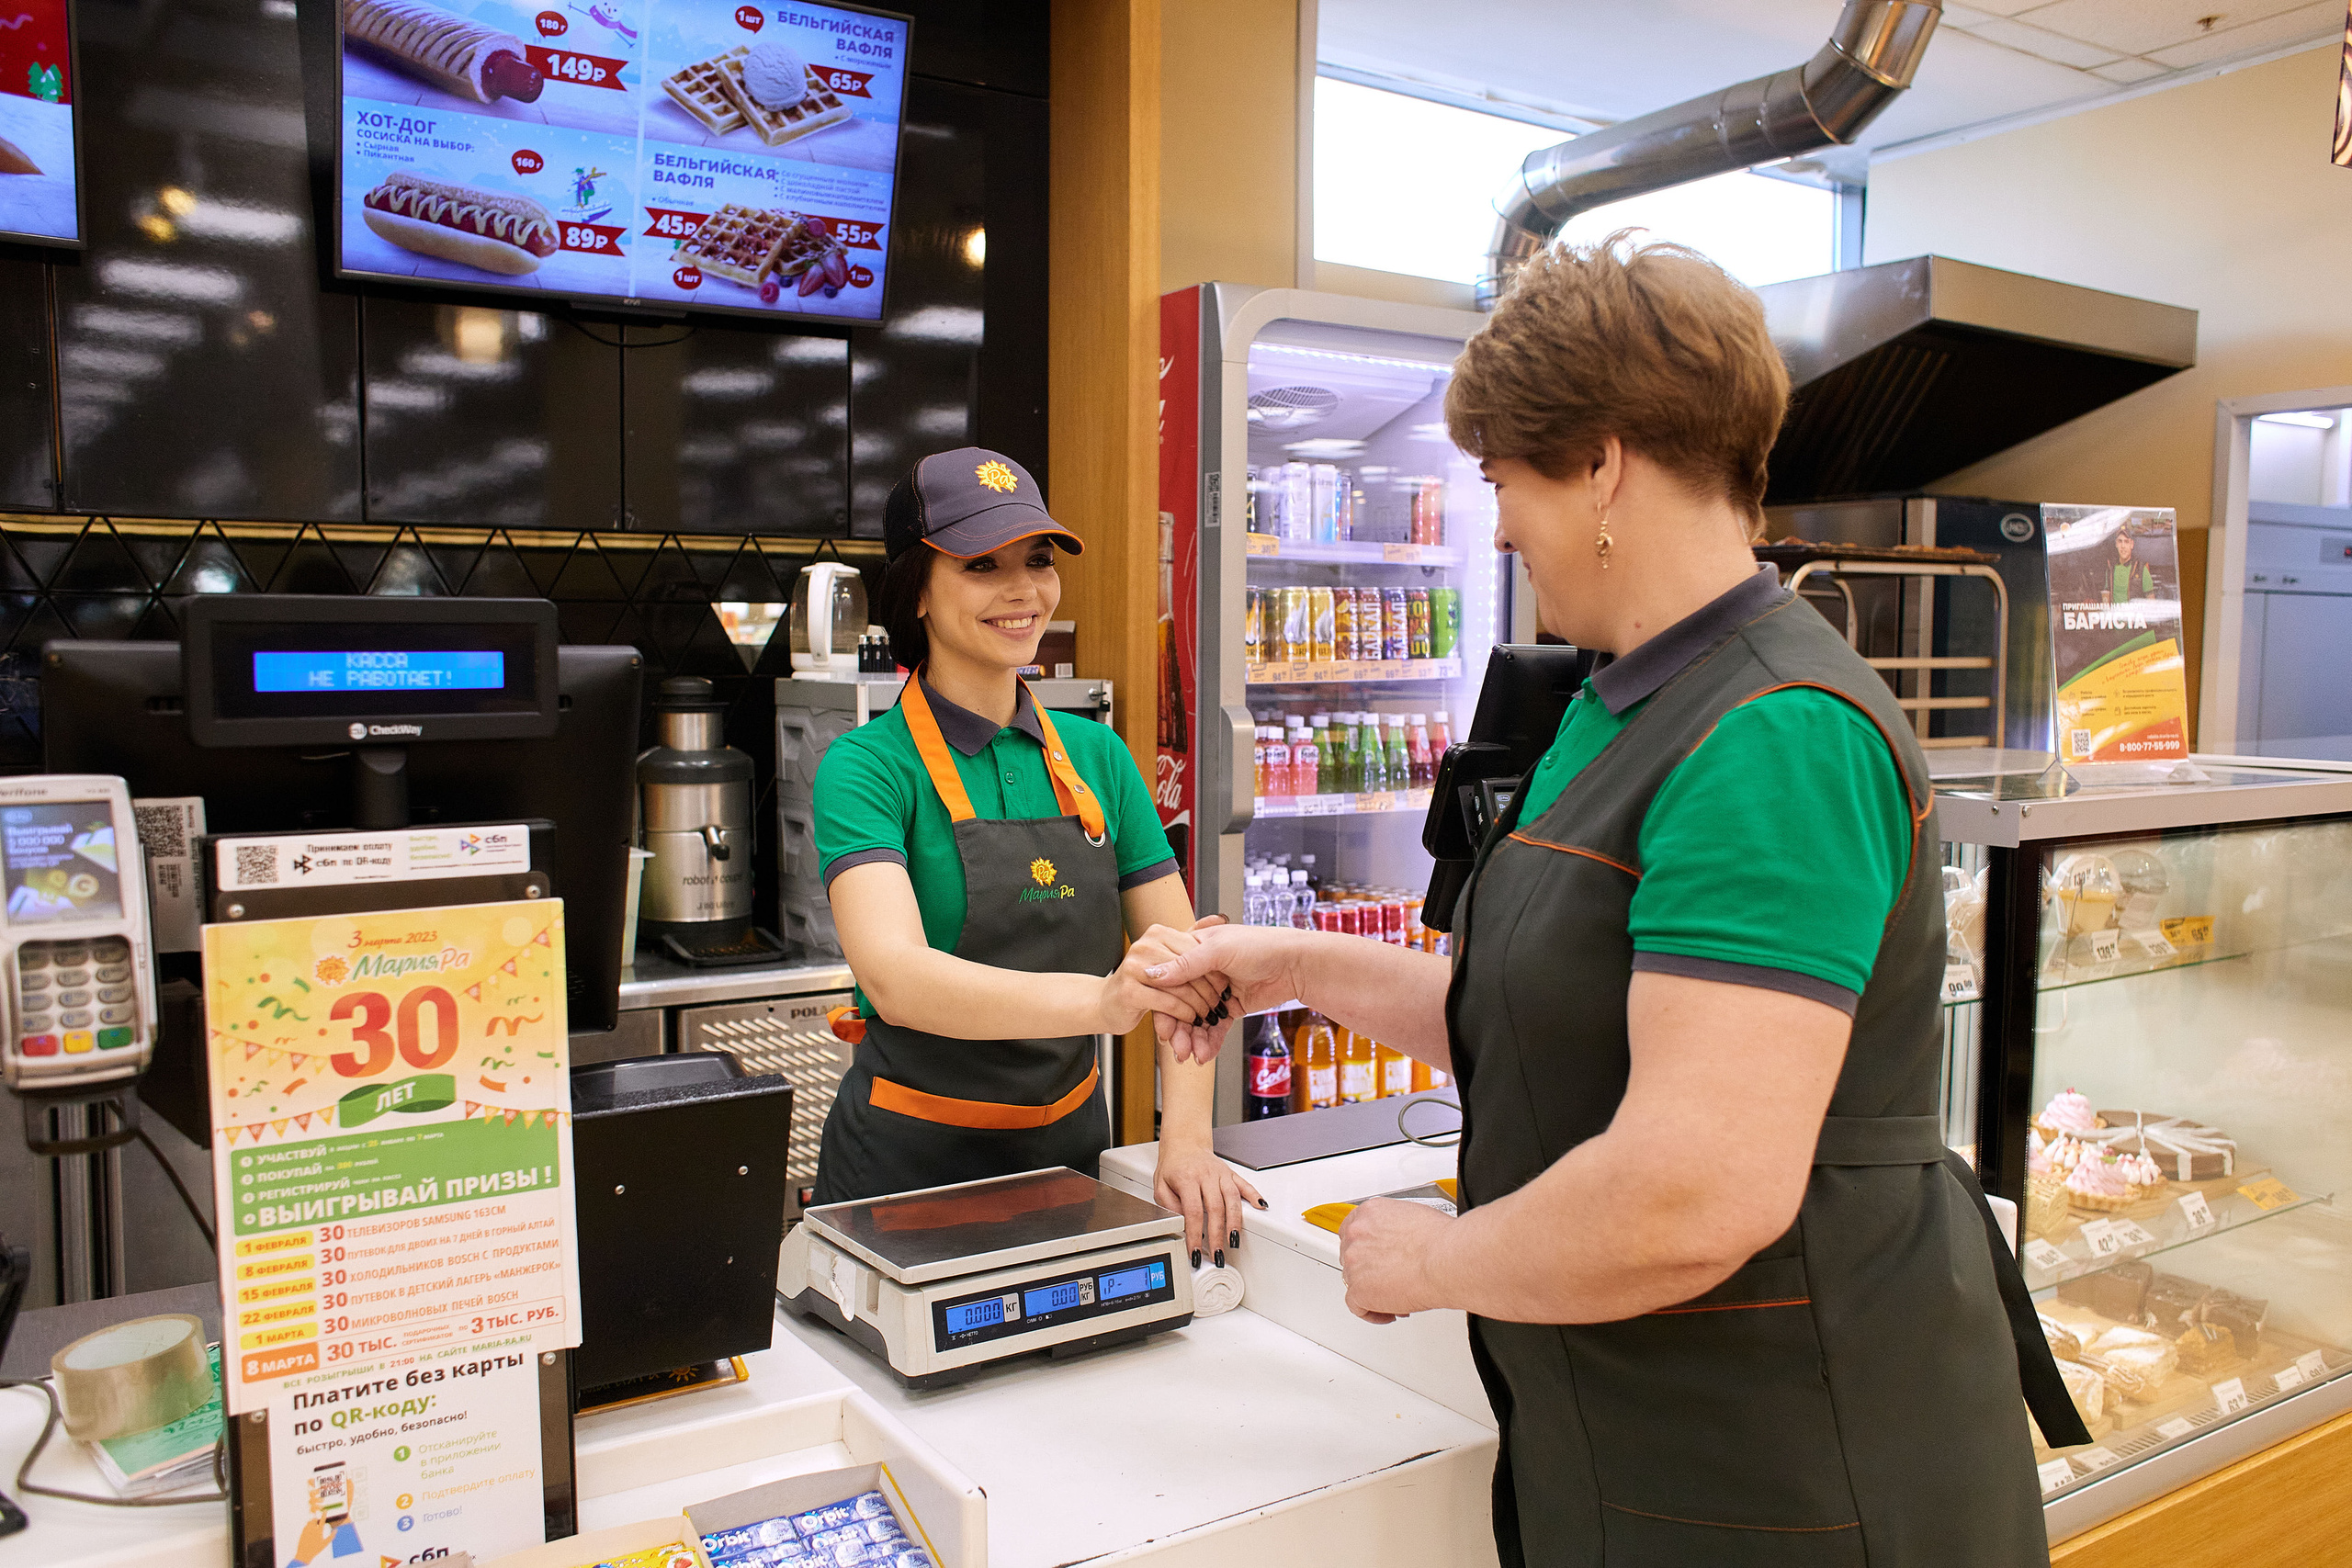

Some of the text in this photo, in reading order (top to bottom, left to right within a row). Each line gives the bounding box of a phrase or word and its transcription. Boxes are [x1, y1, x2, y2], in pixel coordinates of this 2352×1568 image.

[540, 18, 559, 30] 180
[777, 11, 895, 43] БЕЛЬГИЙСКАЯ
[836, 39, 893, 59] ВАФЛЯ
[356, 111, 436, 135] ХОТ-ДОГ
[357, 130, 475, 153] СОСИСКА НА ВЫБОР:
[364, 141, 399, 153] Сырная
[364, 150, 414, 164] Пикантная
[515, 157, 535, 168] 160
[654, 152, 776, 181] БЕЛЬГИЙСКАЯ
[653, 169, 714, 189] ВАФЛЯ
[989, 469, 1010, 484] Ра
[2064, 612, 2148, 630] БАРИСТА
[345, 652, 409, 668] КАССА
[309, 671, 452, 687] НЕ РАБОТАЕТ!
[369, 725, 422, 736] CheckWay
[307, 842, 392, 853] Принимаем оплату
[485, 835, 507, 843] сбп
[346, 931, 363, 948] 3
[405, 931, 438, 944] 2023
[329, 985, 459, 1078] 30
[375, 1081, 418, 1113] ЛЕТ
[257, 1144, 327, 1166] УЧАСТВУЙ
[257, 1162, 322, 1182] ПОКУПАЙ
[258, 1177, 351, 1201] РЕГИСТРИРУЙ
[258, 1166, 552, 1227] ВЫИГРЫВАЙ ПРИЗЫ !
[320, 1224, 345, 1243] 30
[347, 1218, 420, 1238] ТЕЛЕВИЗОРОВ
[422, 1210, 471, 1226] SAMSUNG
[244, 1236, 307, 1253] 1 ФЕВРАЛЯ
[321, 1216, 555, 1264] 30 ПУТЕВОК ДЛЯ ДВОИХ НА 7 ДНЕЙ В ГОРНЫЙ АЛТАЙ
[245, 1259, 308, 1277] 8 ФЕВРАЛЯ
[322, 1239, 560, 1287] 30 ХОЛОДИЛЬНИКОВ BOSCH С ПРОДУКТАМИ
[323, 1261, 561, 1310] 30 ПУТЕВОК В ДЕТСКИЙ ЛАГЕРЬ «МАНЖЕРОК»
[1080, 1281, 1092, 1292] РУБ
[1150, 1271, 1165, 1282] РУБ
[243, 1281, 313, 1301] 15 ФЕВРАЛЯ
[1052, 1286, 1077, 1307] 0.00
[243, 1305, 314, 1325] 22 ФЕВРАЛЯ
[324, 1290, 519, 1334] 30 МИКРОВОЛНОВЫХ ПЕЧЕЙ BOSCH
[965, 1303, 1001, 1325] 0.000
[1005, 1301, 1018, 1314] КГ
[403, 1324, 450, 1337] ПОДАРОЧНЫХ
[470, 1306, 560, 1334] 3 ТЫС. РУБ.
[256, 1329, 305, 1344] 1 МАРТА
[401, 1332, 453, 1346] СЕРТИФИКАТОВ
[327, 1337, 397, 1361] 30 ТЫС.
[246, 1353, 316, 1376] 8 МАРТА
[284, 1379, 301, 1388] ВСЕ
[307, 1365, 374, 1384] РОЗЫГРЫШИ
[390, 1357, 414, 1368] 21:00
[419, 1354, 433, 1362] НА
[437, 1346, 468, 1359] САЙТЕ
[472, 1334, 532, 1352] MARIA-RA.RU
[293, 1352, 524, 1412] Платите без карты
[294, 1393, 436, 1436] по QR-коду:
[297, 1411, 468, 1455] быстро, удобно, безопасно!
[418, 1430, 497, 1454] Отсканируйте
[430, 1442, 501, 1465] приложении
[421, 1466, 454, 1480] банка
[423, 1477, 495, 1501] Подтвердите
[498, 1469, 535, 1483] оплату
[424, 1506, 462, 1522] Готово!
[801, 1506, 851, 1530] Orbit
[702, 1530, 751, 1552] Orbit
